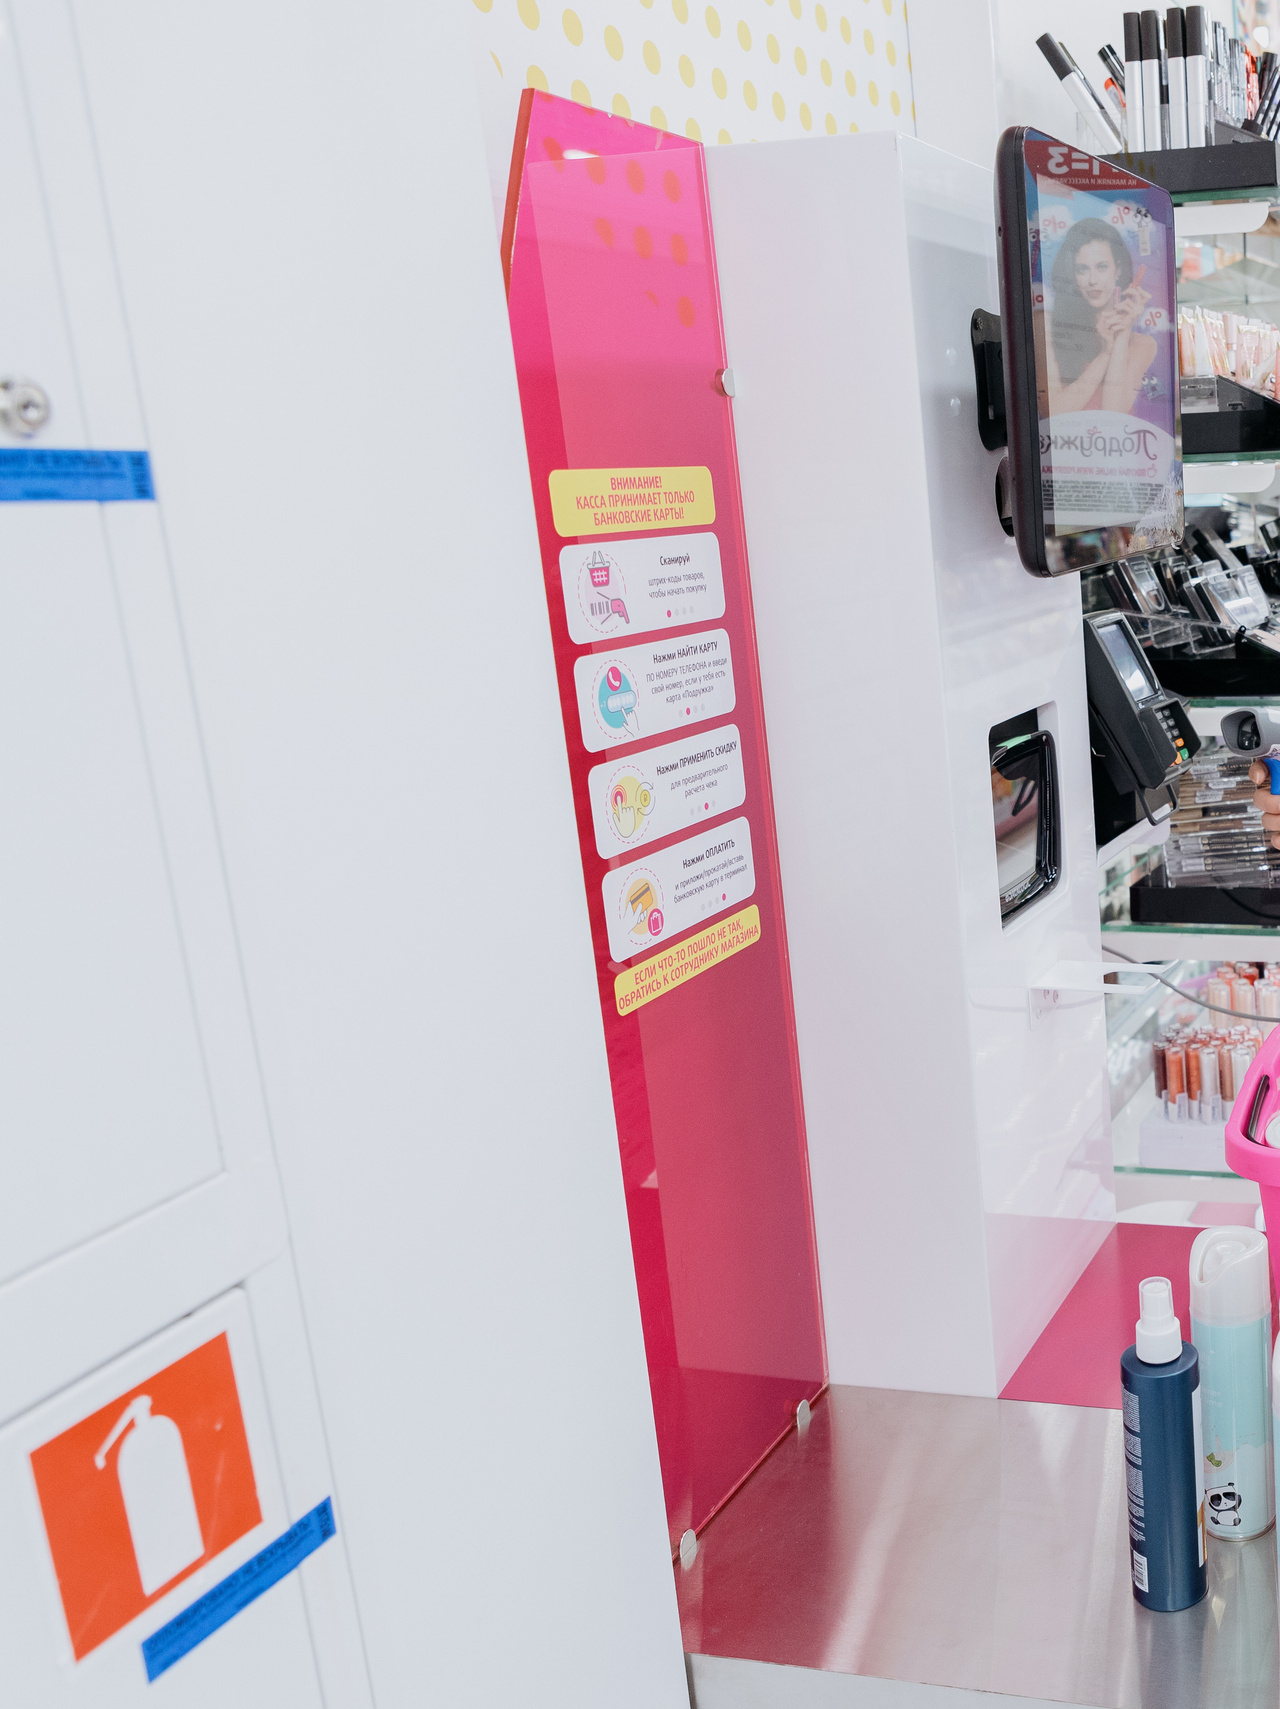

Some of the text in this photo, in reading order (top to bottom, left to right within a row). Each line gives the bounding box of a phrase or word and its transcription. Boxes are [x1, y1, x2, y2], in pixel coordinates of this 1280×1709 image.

[610, 476, 662, 490] ВНИМАНИЕ!
[576, 491, 695, 510] КАССА ПРИНИМАЕТ ТОЛЬКО
[593, 507, 685, 526] БАНКОВСКИЕ КАРТЫ!
[659, 554, 690, 566] Сканируй
[648, 572, 705, 587] штрих-коды товаров,
[648, 583, 707, 599] чтобы начать покупку
[653, 641, 718, 664] Нажми НАЙТИ КАРТУ
[646, 672, 655, 682] ПО
[656, 667, 678, 680] НОМЕРУ
[679, 662, 707, 676] ТЕЛЕФОНА
[713, 658, 727, 667] введи
[651, 681, 664, 694] свой
[665, 679, 684, 692] номер,
[685, 676, 697, 687] если
[702, 672, 714, 682] тебя
[715, 670, 726, 679] есть
[666, 686, 714, 704] карта «Подружка»
[656, 741, 737, 776] Нажми ПРИМЕНИТЬ СКИДКУ
[670, 763, 728, 791] для предварительного
[684, 779, 718, 799] расчета чека
[682, 839, 735, 869] Нажми ОПЛАТИТЬ
[673, 886, 705, 904] банковскую
[705, 878, 720, 891] карту
[724, 865, 747, 881] терминал
[634, 918, 744, 986] ЕСЛИ ЧТО-ТО ПОШЛО НЕ ТАК,
[618, 924, 760, 1010] ОБРАТИСЬ К СОТРУДНИКУ МАГАЗИНА
